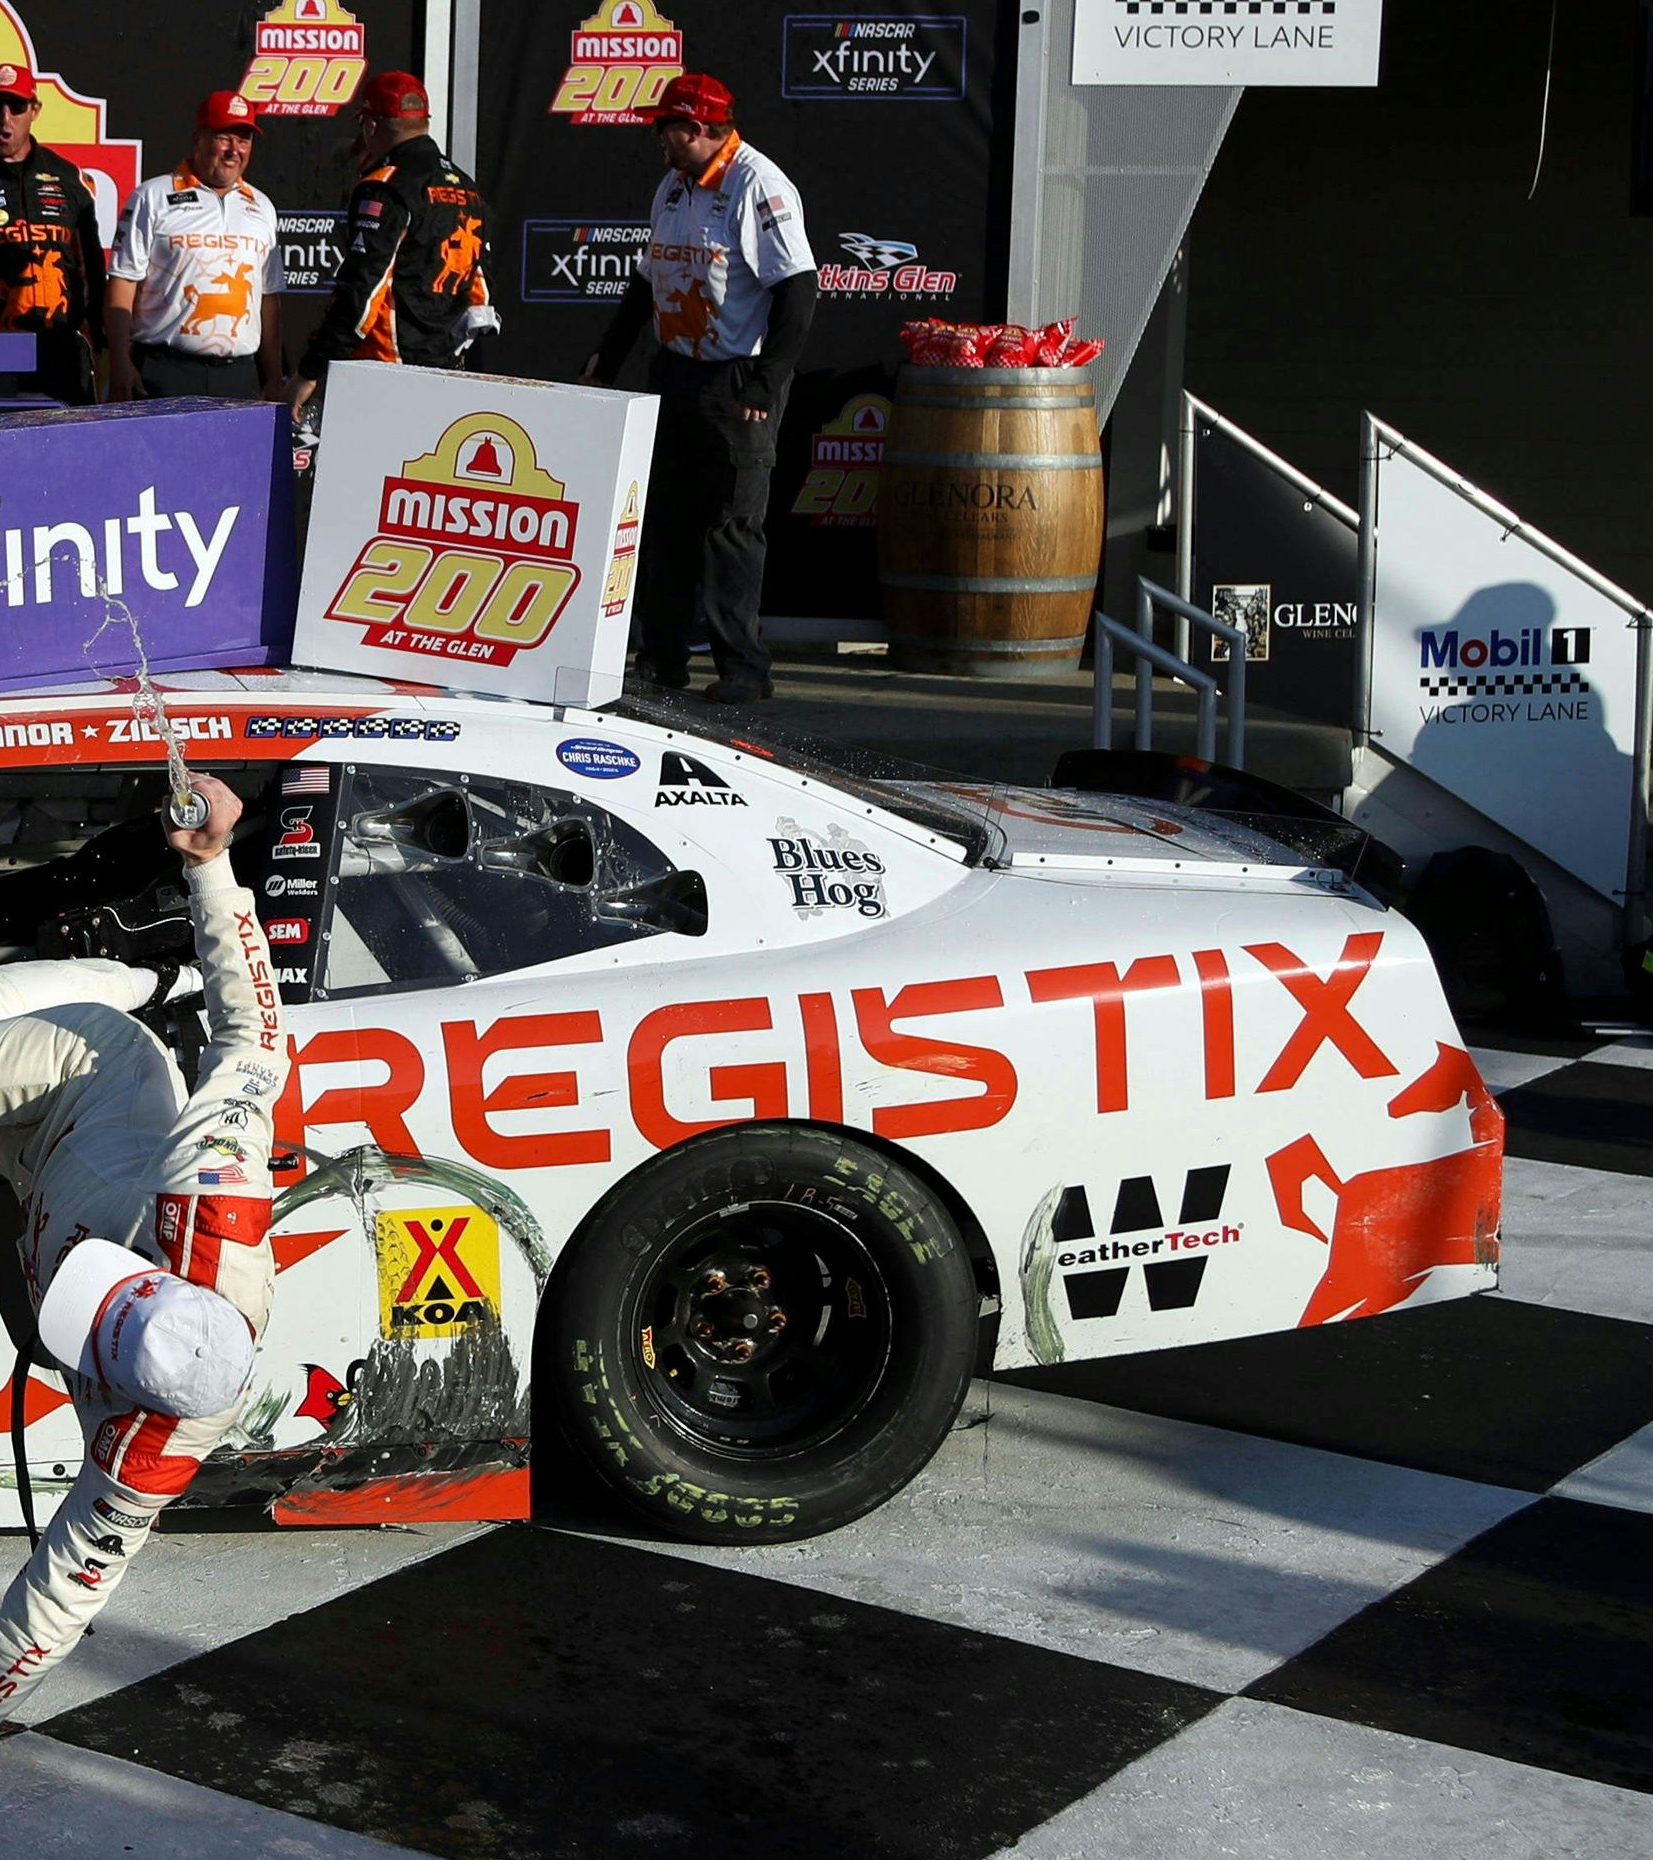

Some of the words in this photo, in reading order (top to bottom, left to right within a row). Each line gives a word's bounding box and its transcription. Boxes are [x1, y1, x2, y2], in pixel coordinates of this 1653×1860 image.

[854, 23, 916, 38] NASCAR
[1114, 25, 1245, 48] VICTORY
[1254, 26, 1335, 48] LANE
[812, 41, 937, 83] xfinity
[240, 57, 366, 103] 200
[552, 66, 683, 111] 200
[847, 77, 899, 92] SERIES
[265, 104, 279, 114] AT
[281, 104, 300, 114] THE
[302, 105, 329, 115] GLEN
[580, 113, 596, 123] AT
[596, 113, 615, 123] THE
[277, 218, 335, 233] NASCAR
[592, 228, 652, 243] NASCAR
[169, 233, 269, 256] REGISTIX
[279, 238, 345, 277] nity
[551, 245, 644, 286] xfinit
[586, 281, 630, 295] SERIE
[817, 264, 890, 291] tkins
[893, 265, 957, 292] Glen
[816, 291, 951, 301] ERNATIONAL
[817, 441, 885, 461] MISSI
[792, 469, 877, 513] 20
[602, 554, 636, 606] 200
[331, 541, 577, 645] 200
[1274, 603, 1357, 628] GLEN
[380, 630, 406, 645] AT
[410, 633, 443, 651] THE
[447, 638, 495, 659] GLEN
[1302, 629, 1332, 639] WINE
[1419, 628, 1541, 668] Mobil
[1562, 630, 1577, 662] 1
[1419, 702, 1521, 724] VICTORY
[1527, 701, 1589, 721] LANE
[562, 751, 592, 764] CHRIS
[593, 753, 637, 768] RASCHKE
[654, 791, 749, 808] AXALTA
[766, 837, 885, 874] Blues
[287, 878, 318, 889] Miller
[790, 872, 886, 917] Hog
[268, 924, 301, 939] SEM
[233, 910, 279, 1052] REGISTIX
[273, 930, 1401, 1188] REGISTIX
[164, 1201, 178, 1242] OMP
[392, 1302, 487, 1326] KOA
[96, 1423, 117, 1460] OMP
